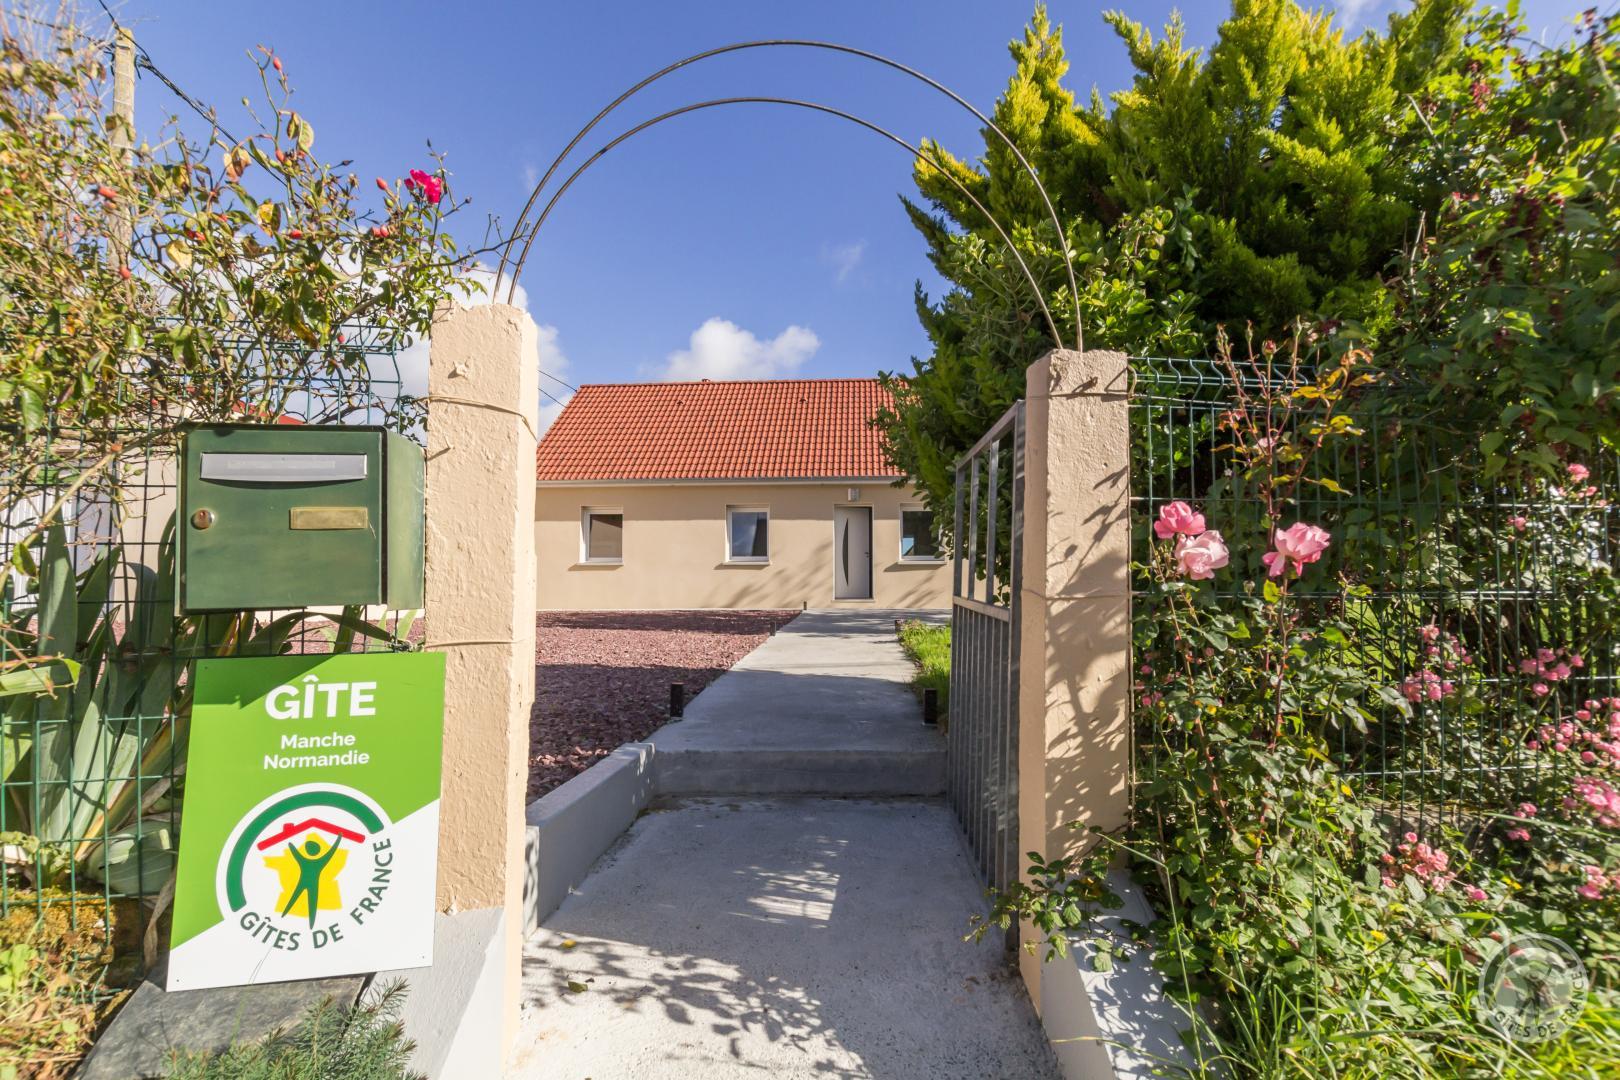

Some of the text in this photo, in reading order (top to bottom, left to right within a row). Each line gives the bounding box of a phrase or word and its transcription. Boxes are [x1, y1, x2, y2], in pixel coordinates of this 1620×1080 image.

[265, 674, 377, 721] GÎTE
[281, 732, 355, 750] Manche
[264, 750, 370, 770] Normandie
[240, 838, 393, 951] GÎTES DE FRANCE
